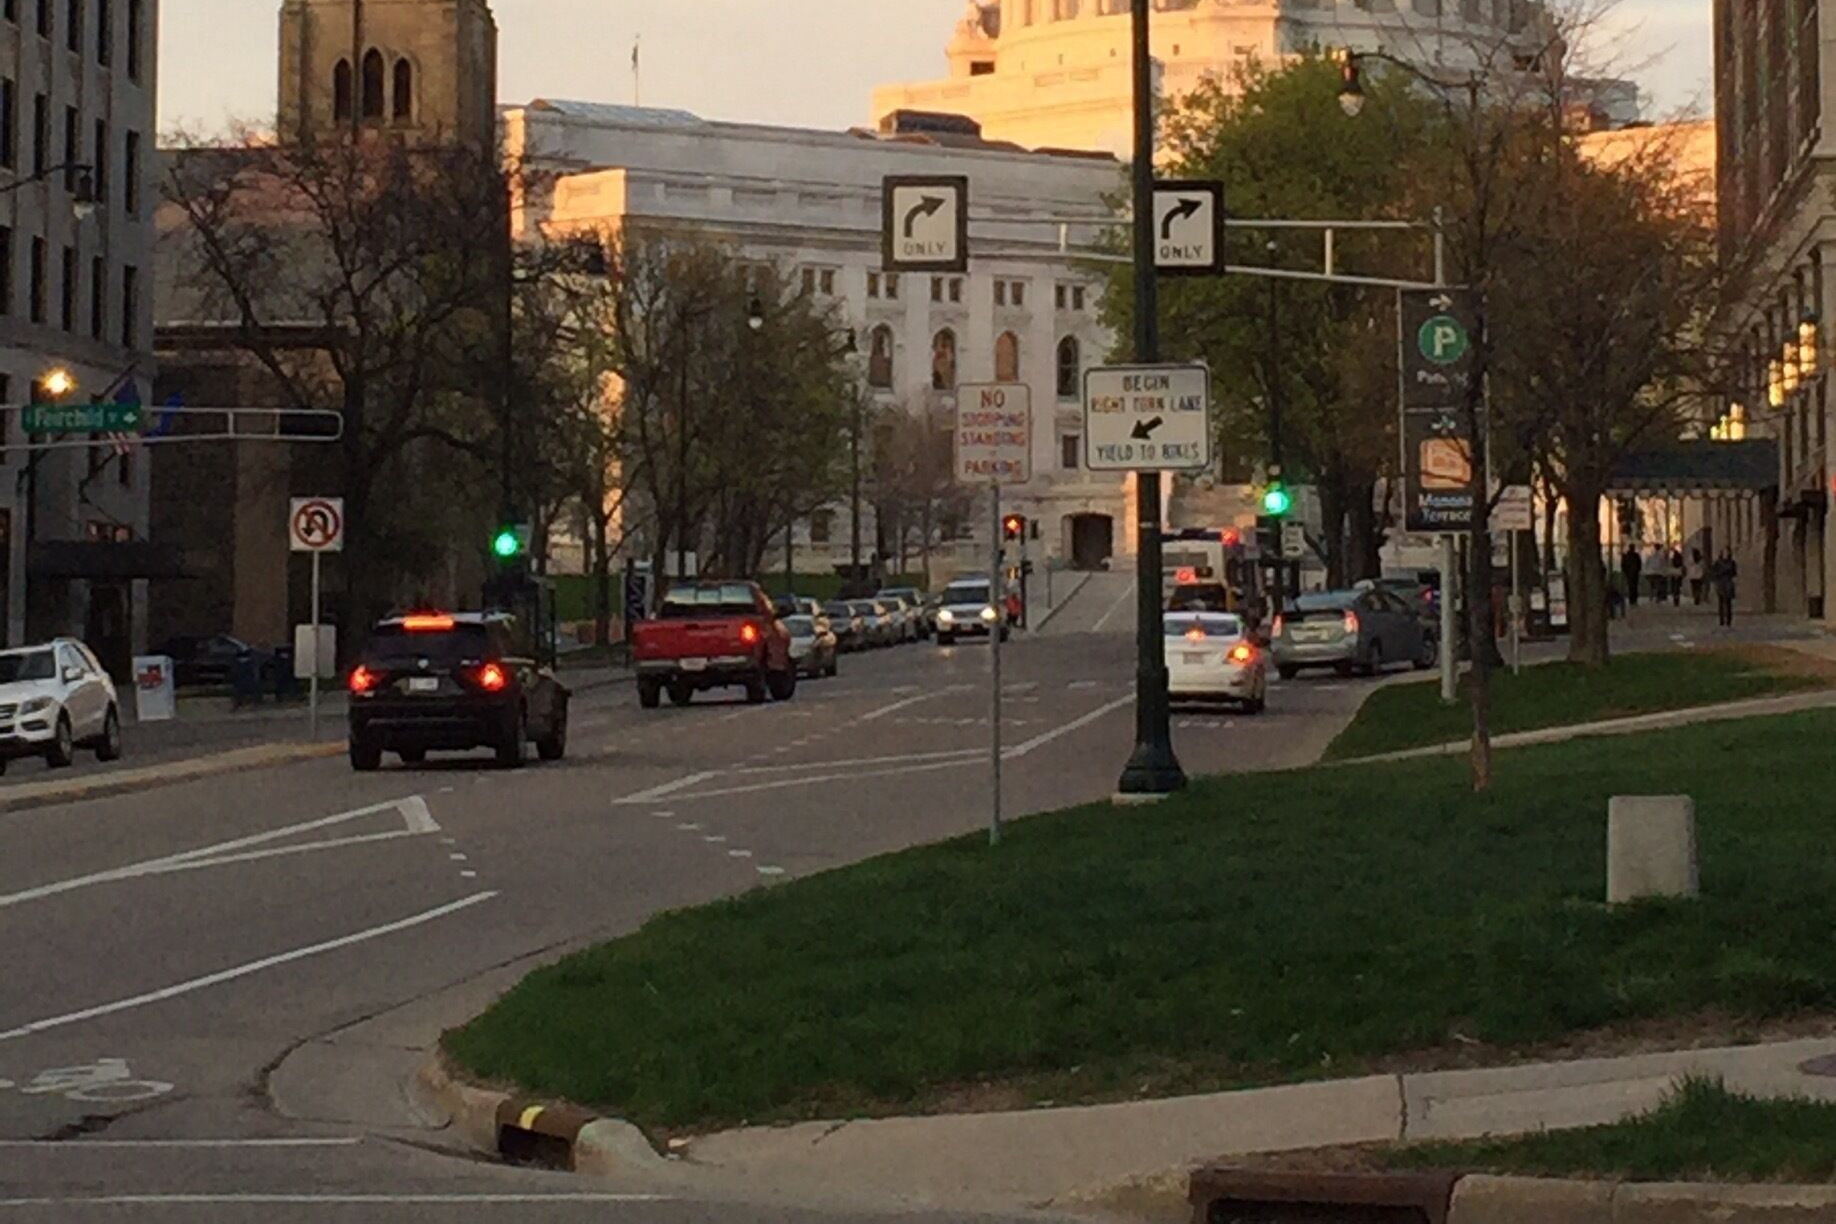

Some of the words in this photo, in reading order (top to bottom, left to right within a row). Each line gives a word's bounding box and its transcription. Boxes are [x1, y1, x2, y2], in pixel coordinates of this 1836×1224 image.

[903, 241, 946, 256] ONLY
[1160, 245, 1202, 259] ONLY
[1434, 326, 1457, 356] P
[1123, 375, 1170, 392] BEGIN
[981, 389, 1005, 408] NO
[1091, 396, 1126, 413] RIGHT
[1133, 396, 1165, 412] TURN
[1170, 395, 1202, 412] LANE
[1096, 444, 1133, 461] YIELD
[1140, 444, 1156, 460] TO
[1162, 442, 1200, 460] BIKES
